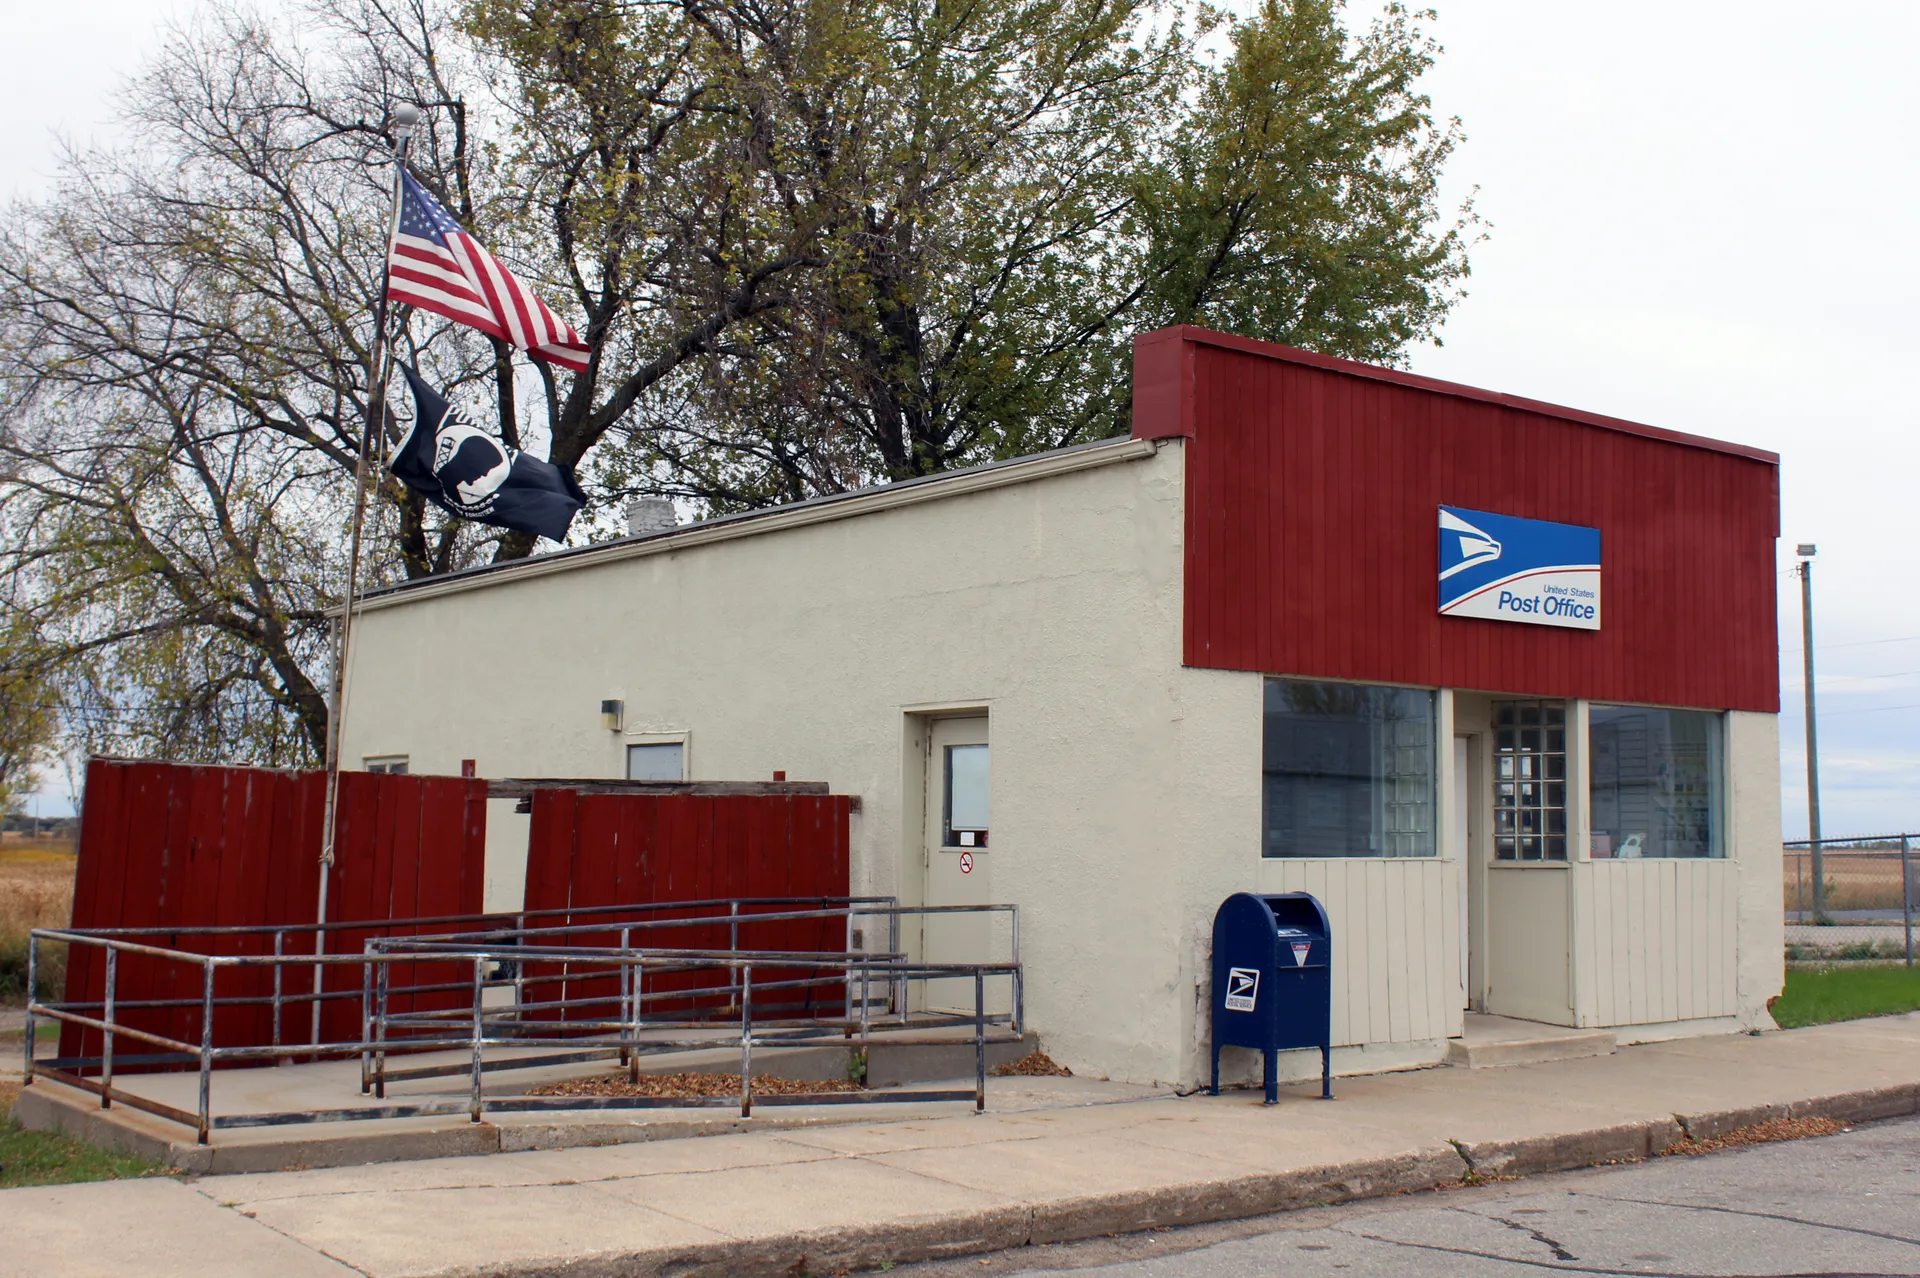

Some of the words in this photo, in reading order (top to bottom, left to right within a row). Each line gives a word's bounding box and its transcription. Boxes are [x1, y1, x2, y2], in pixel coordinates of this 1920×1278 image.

[1543, 584, 1568, 595] United
[1570, 587, 1595, 598] States
[1498, 590, 1540, 613] Post
[1543, 596, 1595, 619] Office
